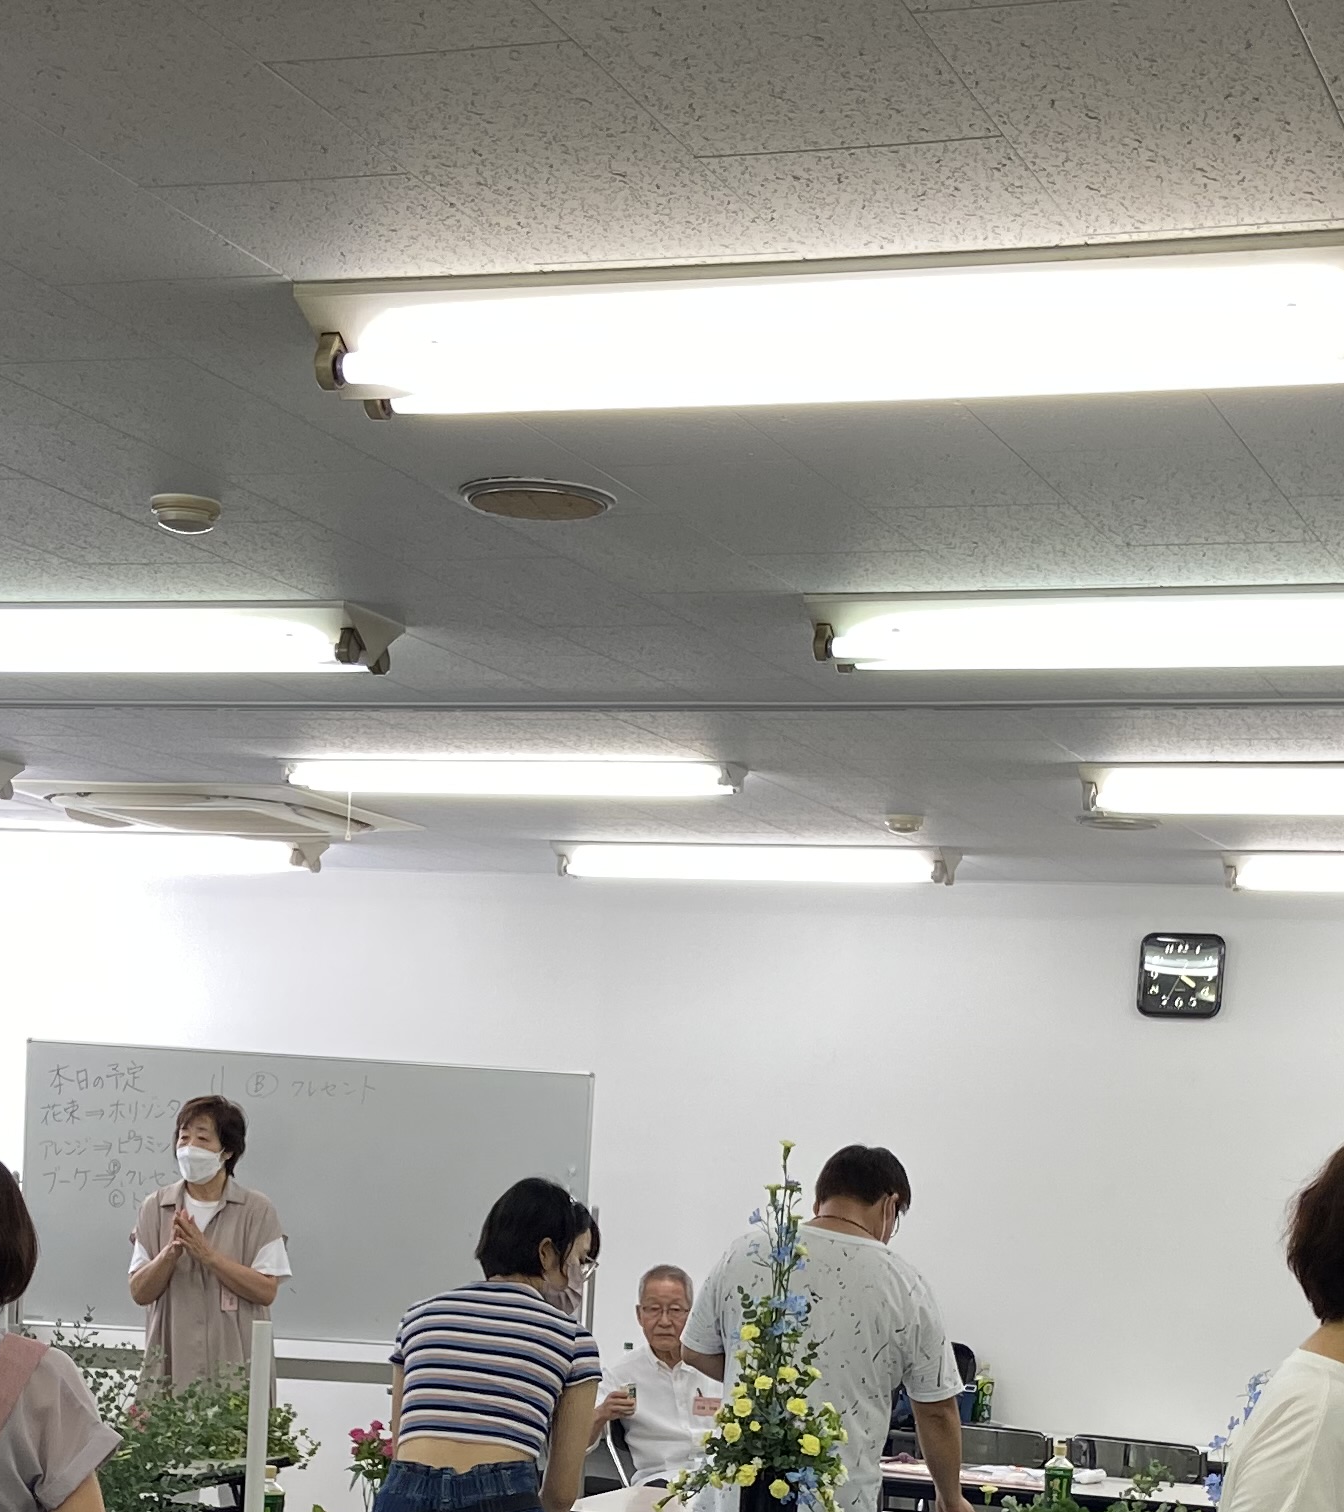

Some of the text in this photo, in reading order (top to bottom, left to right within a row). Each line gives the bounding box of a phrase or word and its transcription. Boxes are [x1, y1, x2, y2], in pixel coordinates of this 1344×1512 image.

[47, 1060, 146, 1096] 本日の予定
[291, 1075, 376, 1104] クレセント
[39, 1137, 91, 1160] アレンジ
[42, 1167, 92, 1195] ブーケ
